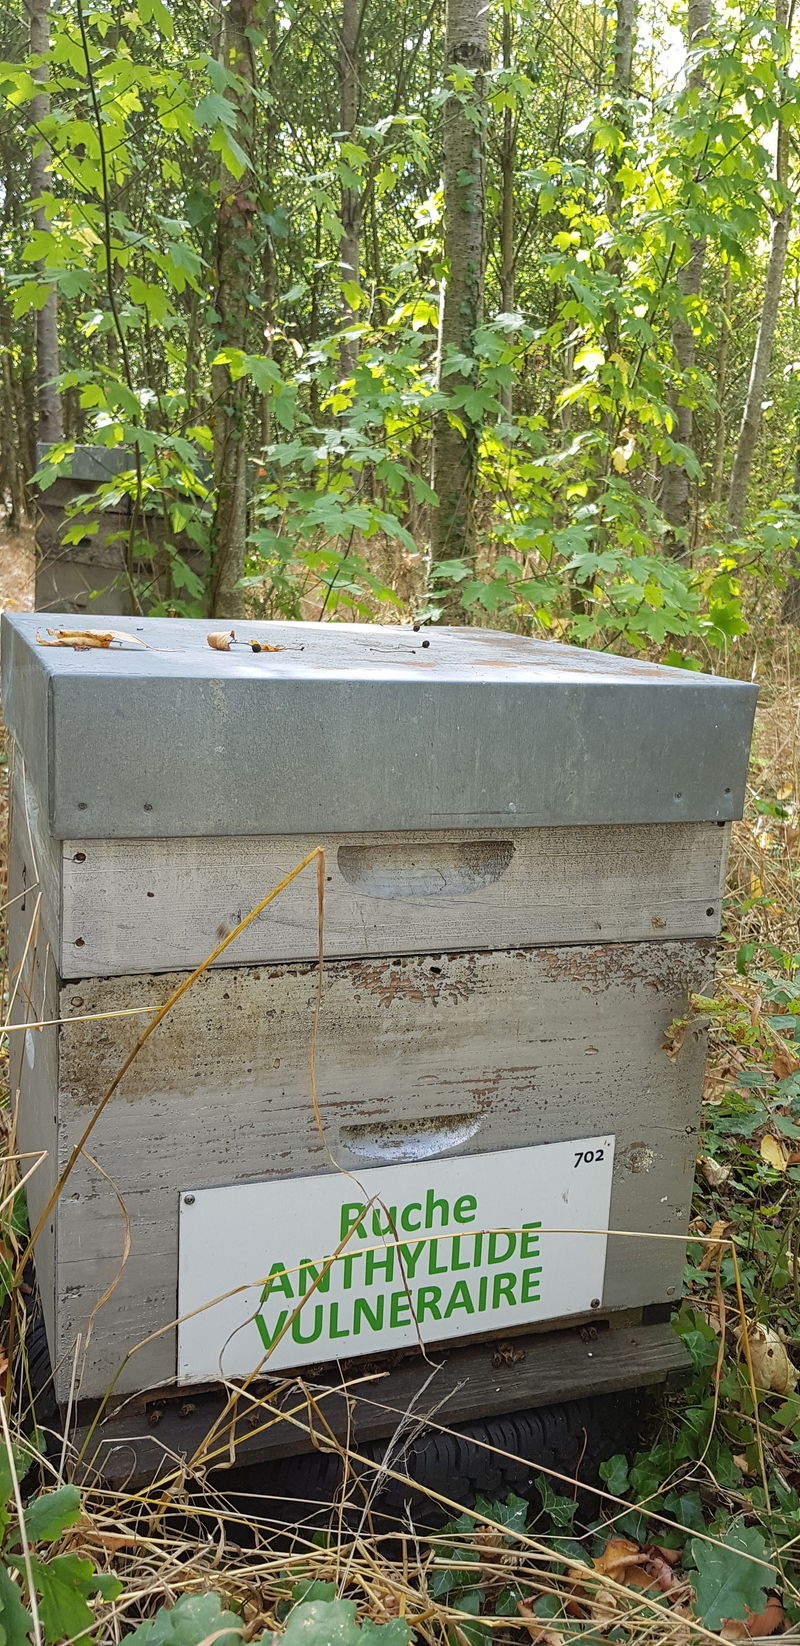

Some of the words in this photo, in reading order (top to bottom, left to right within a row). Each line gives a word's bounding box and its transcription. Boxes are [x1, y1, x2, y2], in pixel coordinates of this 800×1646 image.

[573, 1149, 604, 1168] 702
[340, 1188, 478, 1241] Ruche
[259, 1221, 543, 1304] ANTHYLLIDE
[254, 1266, 543, 1351] VULNERAIRE
